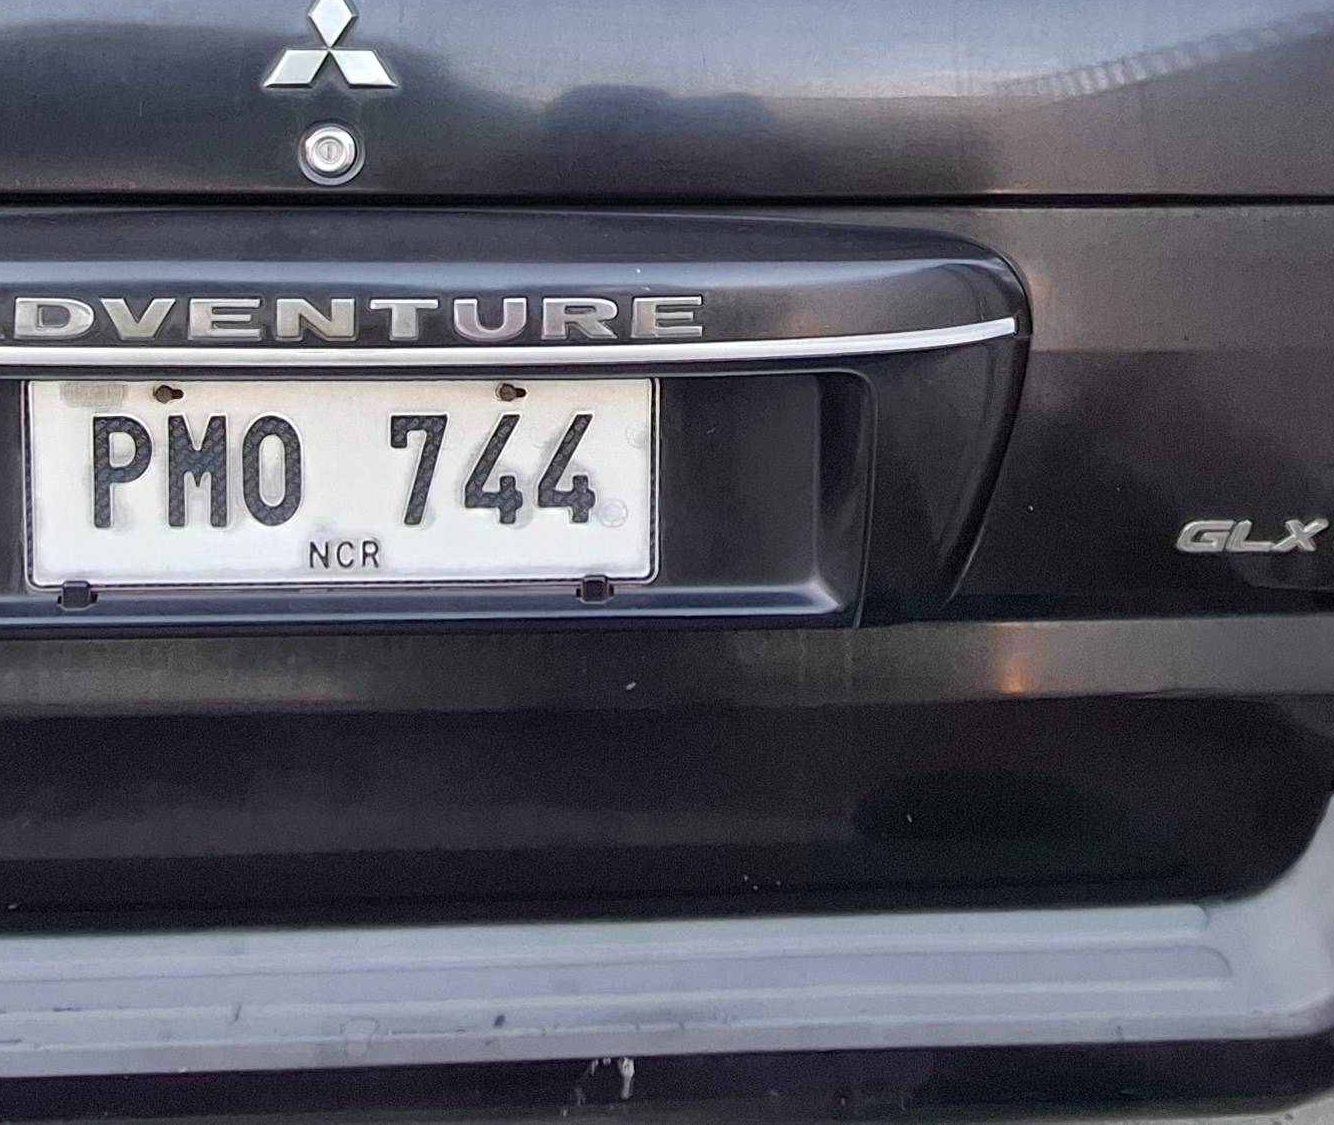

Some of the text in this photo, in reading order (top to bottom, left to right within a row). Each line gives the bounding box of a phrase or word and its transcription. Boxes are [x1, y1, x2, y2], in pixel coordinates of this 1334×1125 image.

[92, 412, 596, 528] PMO 744
[1176, 518, 1330, 552] GLX
[309, 541, 380, 569] NCR
